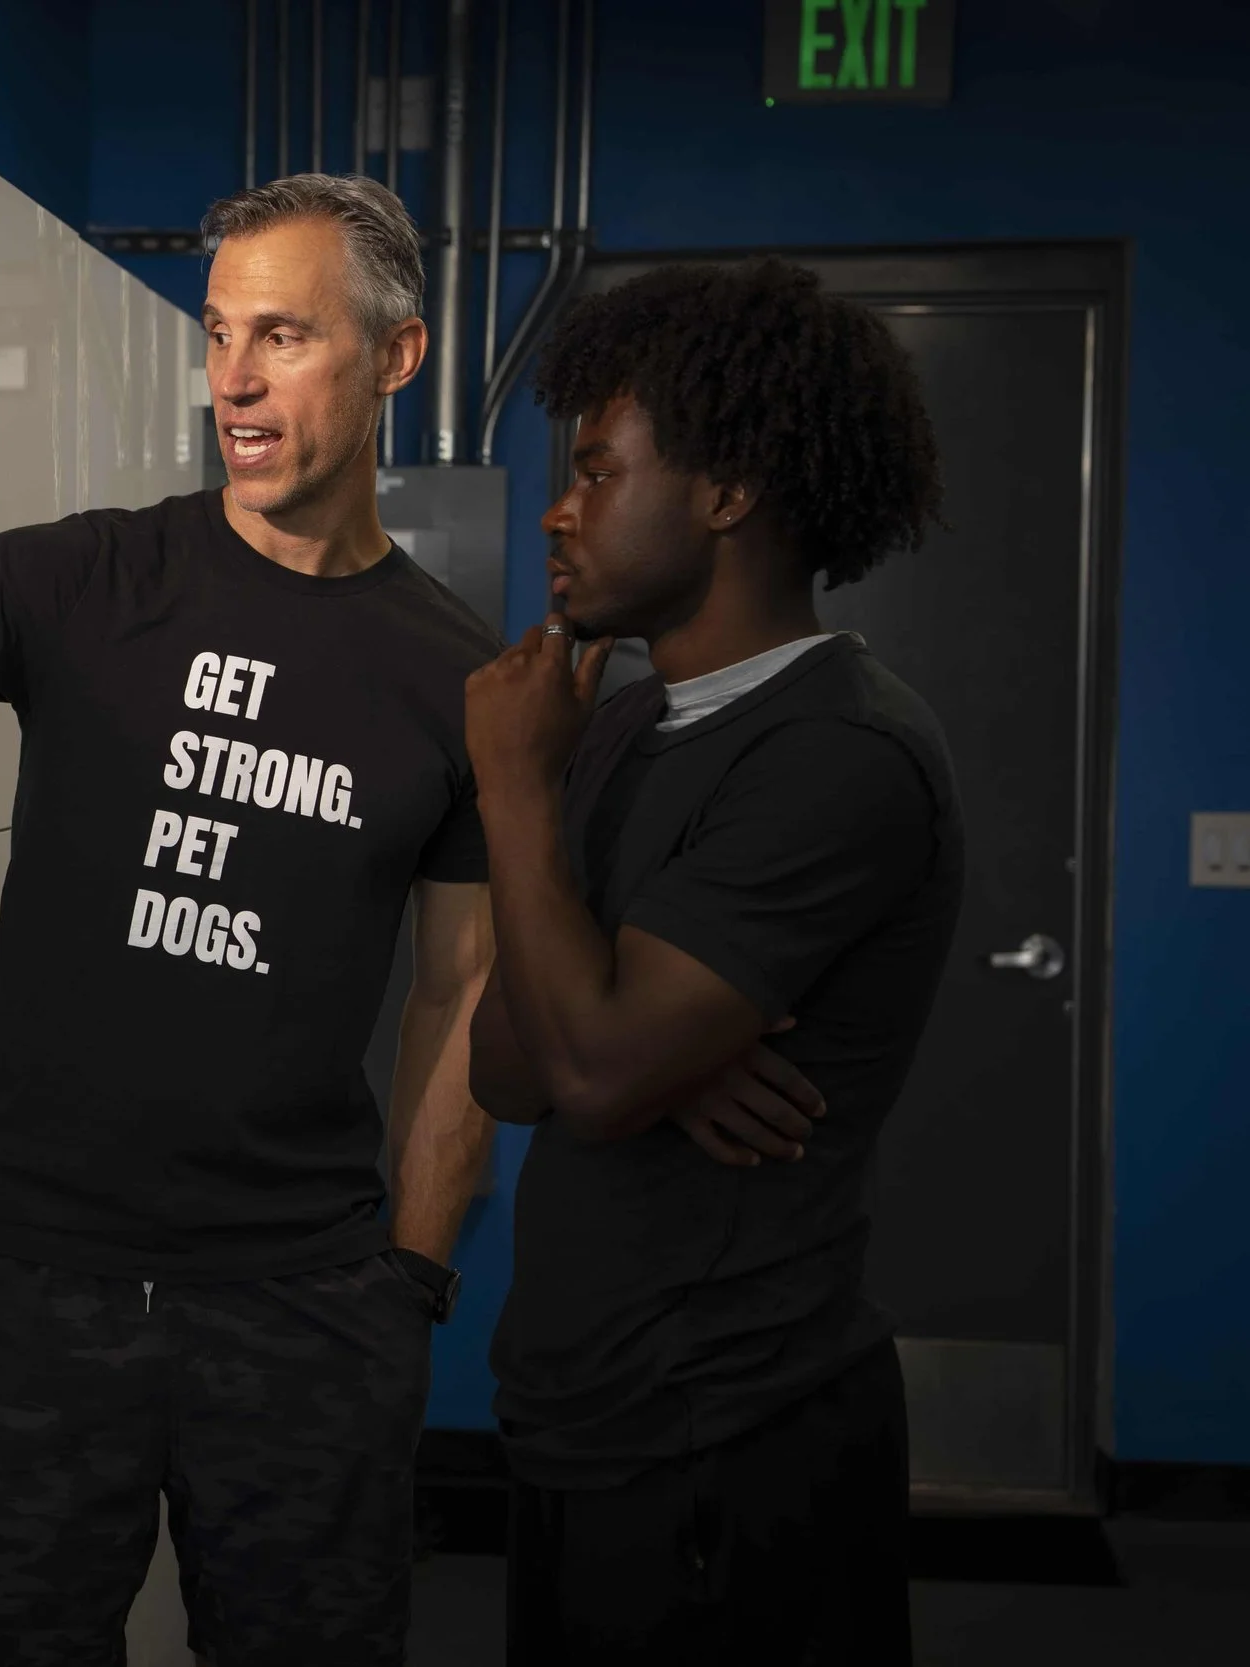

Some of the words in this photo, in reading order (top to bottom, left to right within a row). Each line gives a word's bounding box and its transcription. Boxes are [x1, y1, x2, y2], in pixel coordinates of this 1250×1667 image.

[798, 0, 928, 89] EXIT
[184, 652, 276, 720] GET
[163, 731, 363, 829] STRONG.
[143, 809, 239, 880] PET
[127, 888, 270, 974] DOGS.
